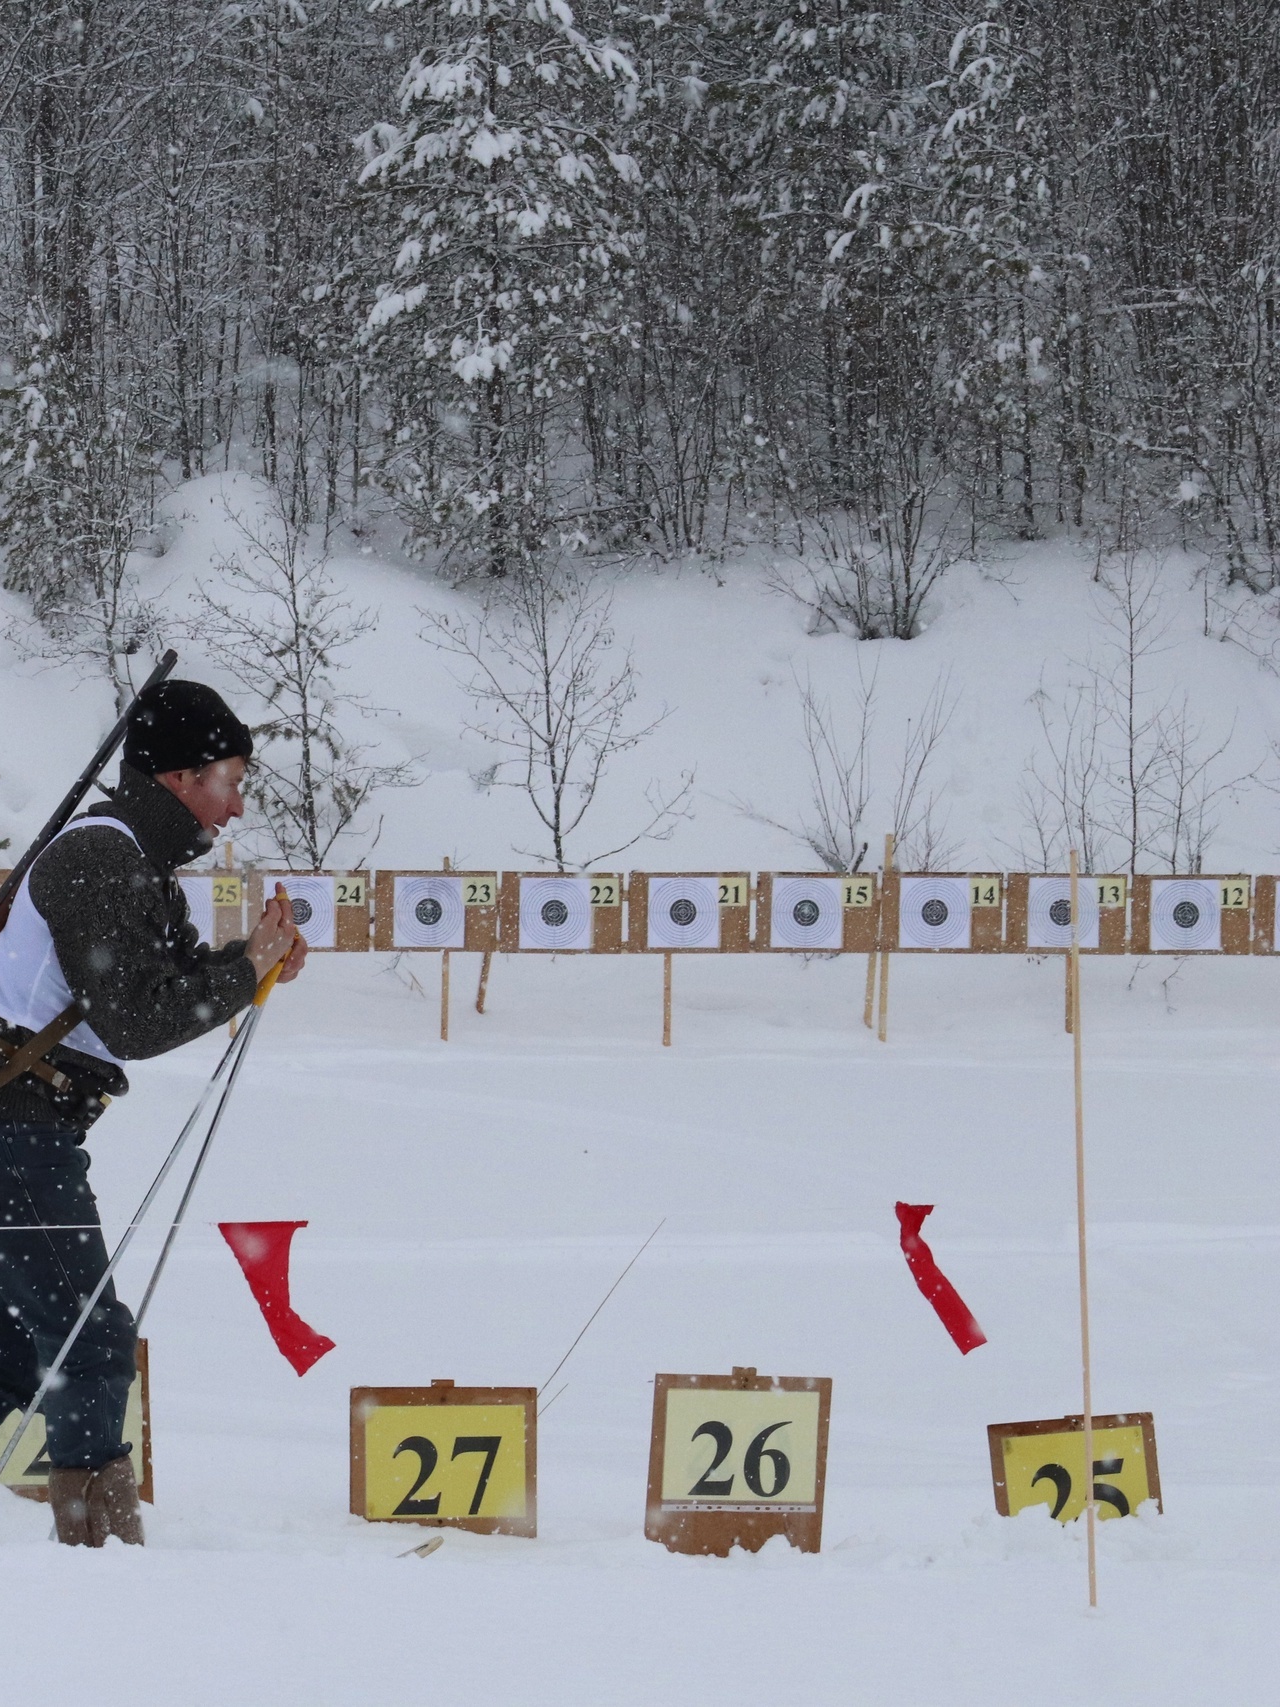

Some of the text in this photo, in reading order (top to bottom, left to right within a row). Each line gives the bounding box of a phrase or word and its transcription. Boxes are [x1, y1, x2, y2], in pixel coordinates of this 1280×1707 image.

[213, 884, 237, 903] 25
[336, 884, 362, 904] 24
[466, 884, 491, 903] 23
[590, 885, 614, 904] 22
[718, 884, 740, 904] 21
[845, 886, 868, 904] 15
[973, 886, 995, 904] 14
[1098, 885, 1120, 904] 13
[1222, 887, 1243, 906] 12
[688, 1421, 792, 1497] 26
[392, 1436, 501, 1515] 27
